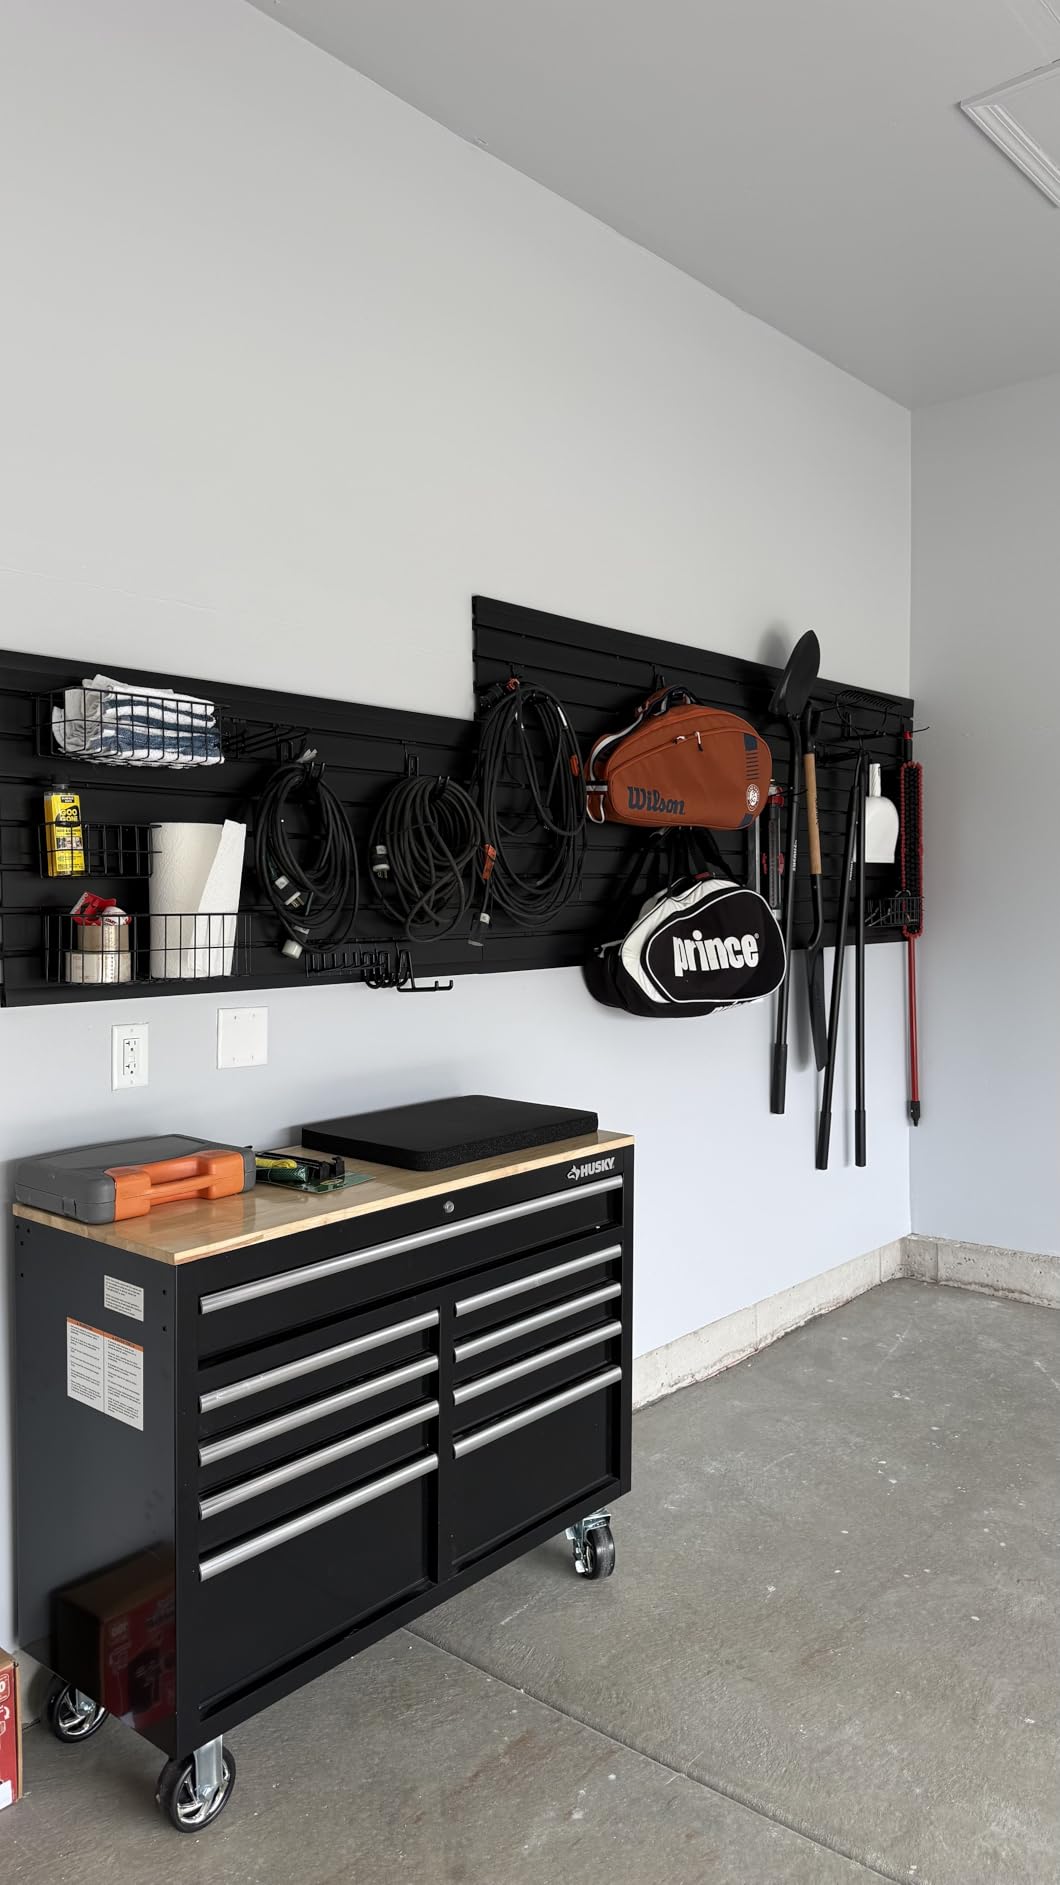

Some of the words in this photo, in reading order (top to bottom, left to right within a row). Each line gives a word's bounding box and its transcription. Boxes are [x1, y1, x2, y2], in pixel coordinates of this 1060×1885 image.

[627, 786, 685, 815] Wilson
[60, 808, 78, 816] GOO
[580, 1157, 615, 1178] HUSKY
